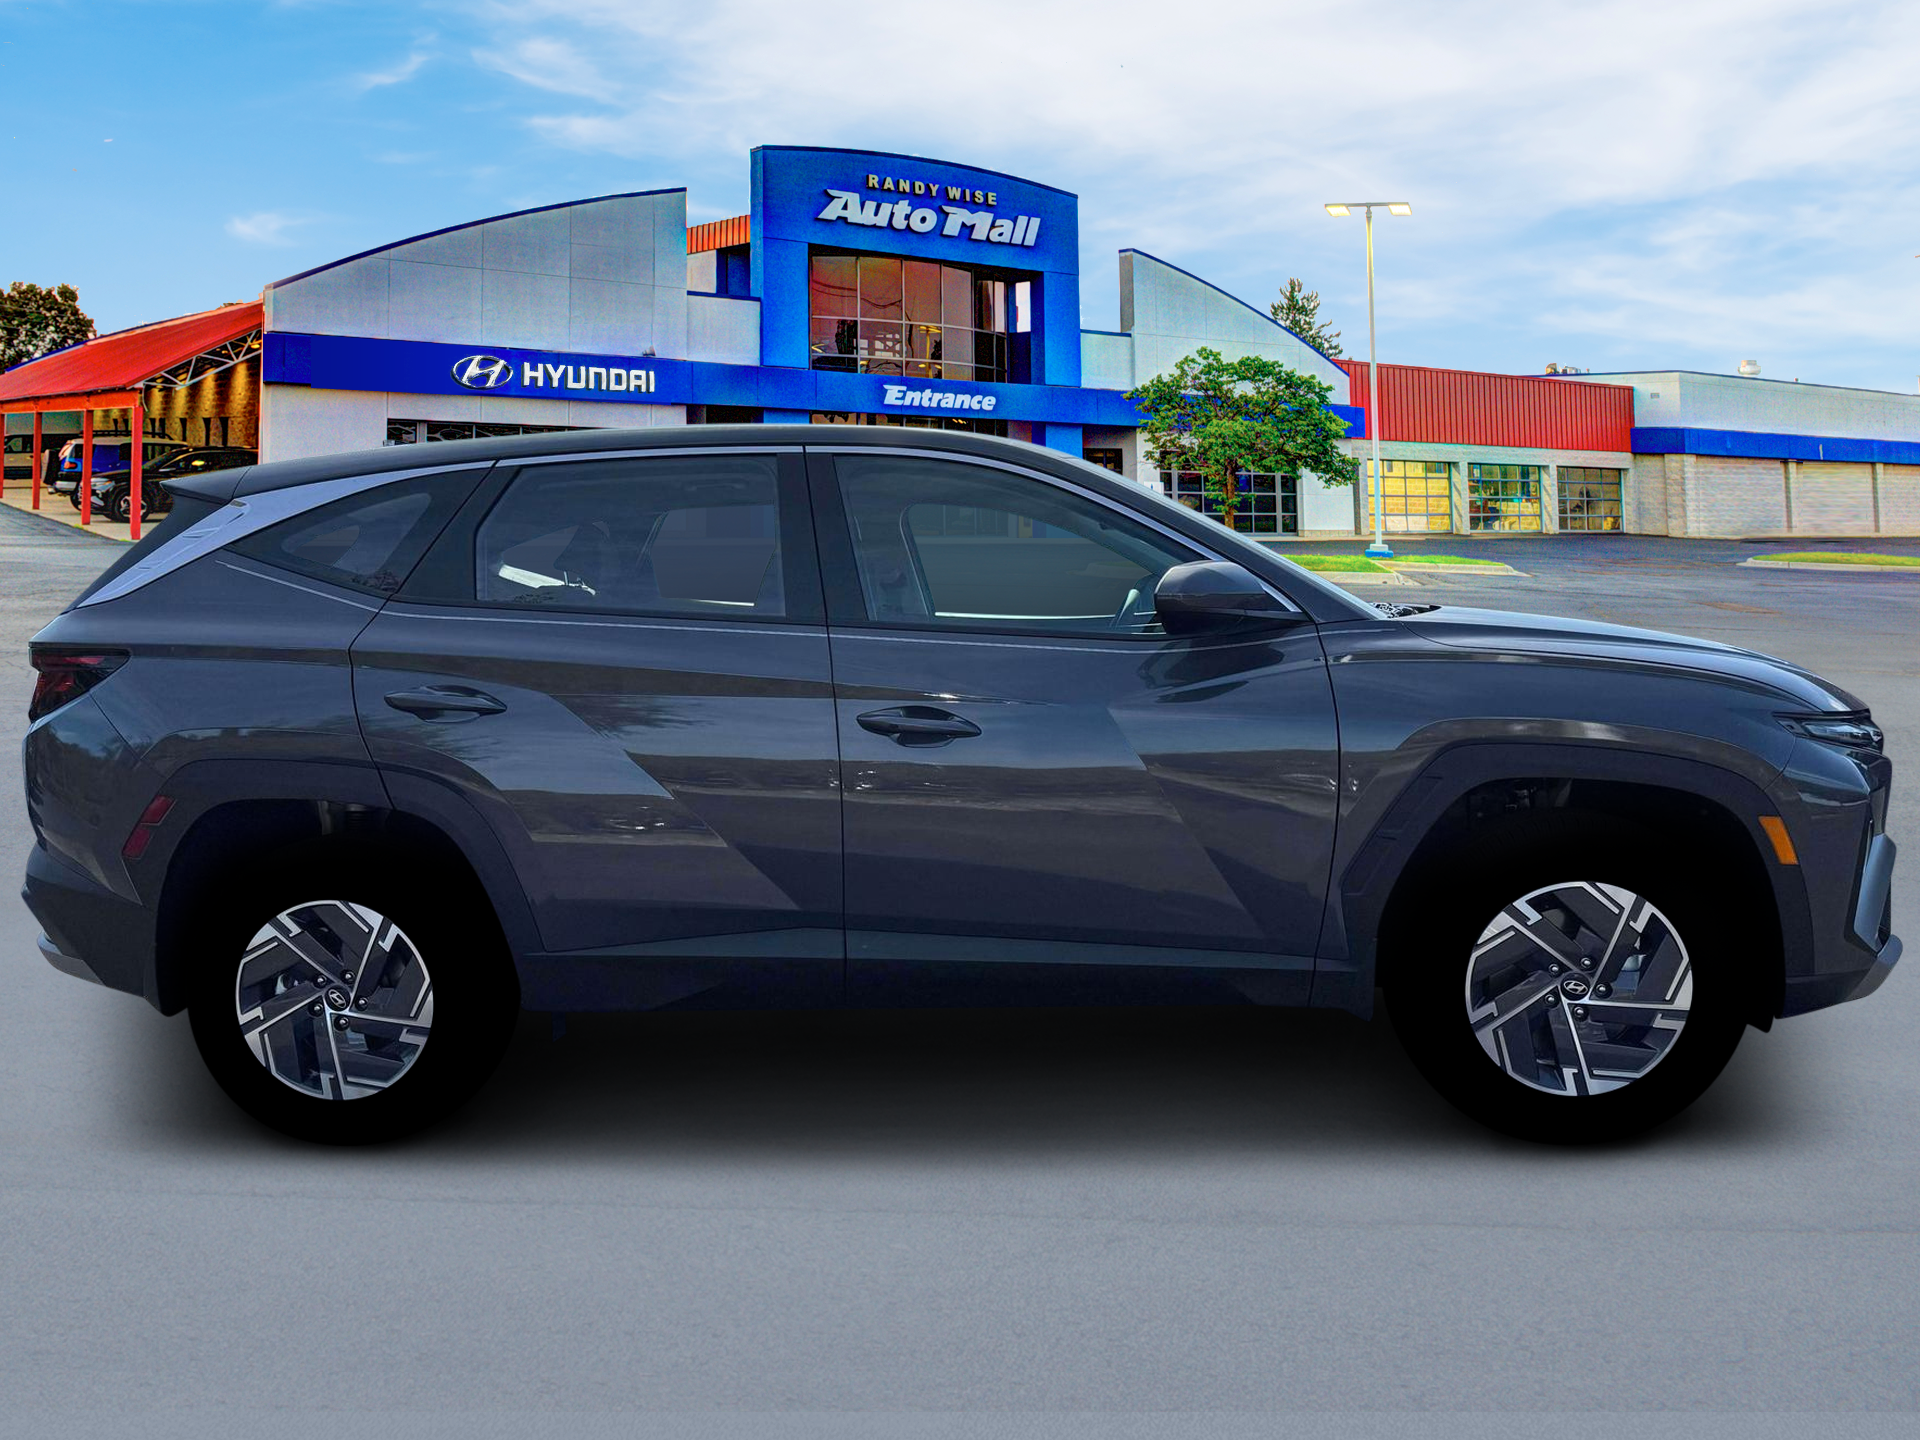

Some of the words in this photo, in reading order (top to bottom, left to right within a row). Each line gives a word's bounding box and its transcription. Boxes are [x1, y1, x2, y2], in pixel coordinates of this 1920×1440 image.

[867, 174, 940, 198] RANDY
[947, 186, 998, 205] WISE
[818, 189, 937, 233] Auto
[942, 205, 1041, 247] Mall
[522, 362, 655, 393] HYUNDAI
[883, 384, 996, 411] Entrance
